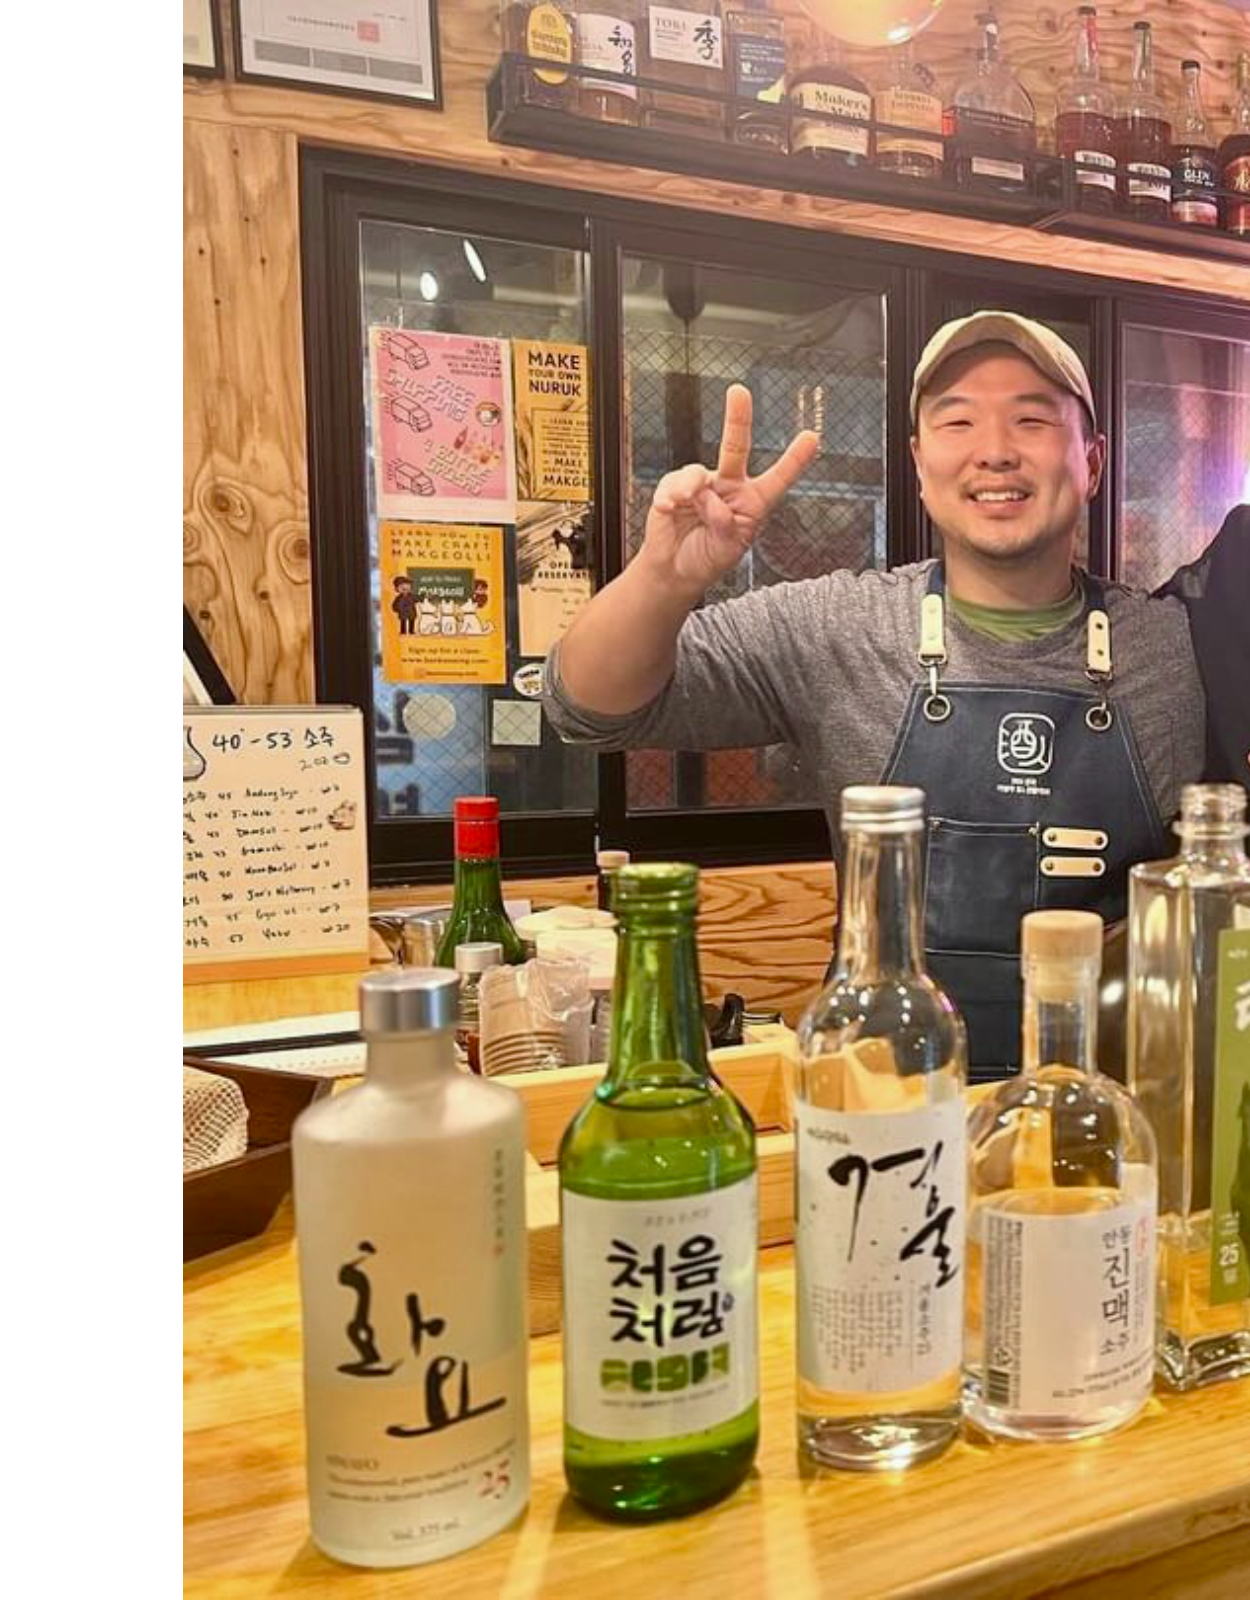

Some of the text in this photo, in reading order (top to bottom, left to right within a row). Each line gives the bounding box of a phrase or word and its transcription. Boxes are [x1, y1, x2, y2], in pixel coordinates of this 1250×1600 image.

[528, 351, 581, 371] MAKE
[528, 369, 581, 381] YOUR OWN
[528, 380, 582, 397] NURUK
[390, 529, 434, 538] LEARN
[439, 531, 468, 540] HOW
[391, 538, 491, 551] MAKE CRAFT
[391, 548, 491, 562] MAKGEOLLI
[304, 726, 334, 748] 소주
[606, 1234, 723, 1297] 처음
[1101, 1247, 1131, 1328] 진맥
[608, 1290, 724, 1348] 처럼
[336, 1240, 507, 1438] 화요
